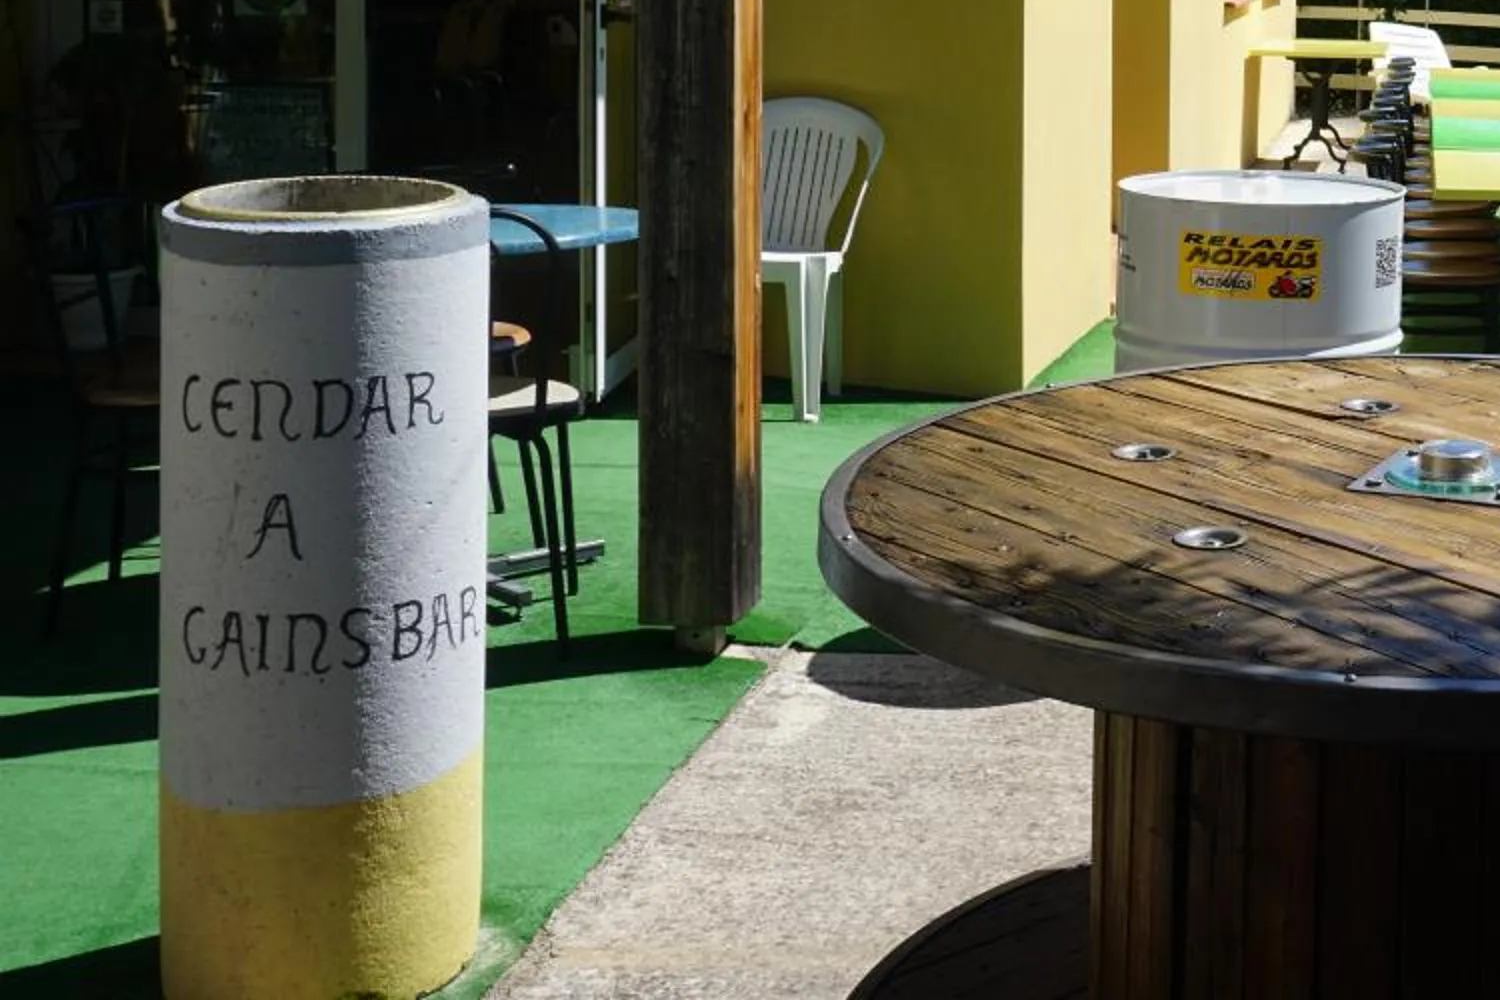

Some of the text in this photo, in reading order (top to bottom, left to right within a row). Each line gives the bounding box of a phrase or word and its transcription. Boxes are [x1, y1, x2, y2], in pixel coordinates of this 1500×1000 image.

[1183, 232, 1318, 250] RELAIS
[1184, 246, 1318, 269] MOTARDS
[182, 372, 444, 441] CENDAR
[245, 493, 303, 561] A
